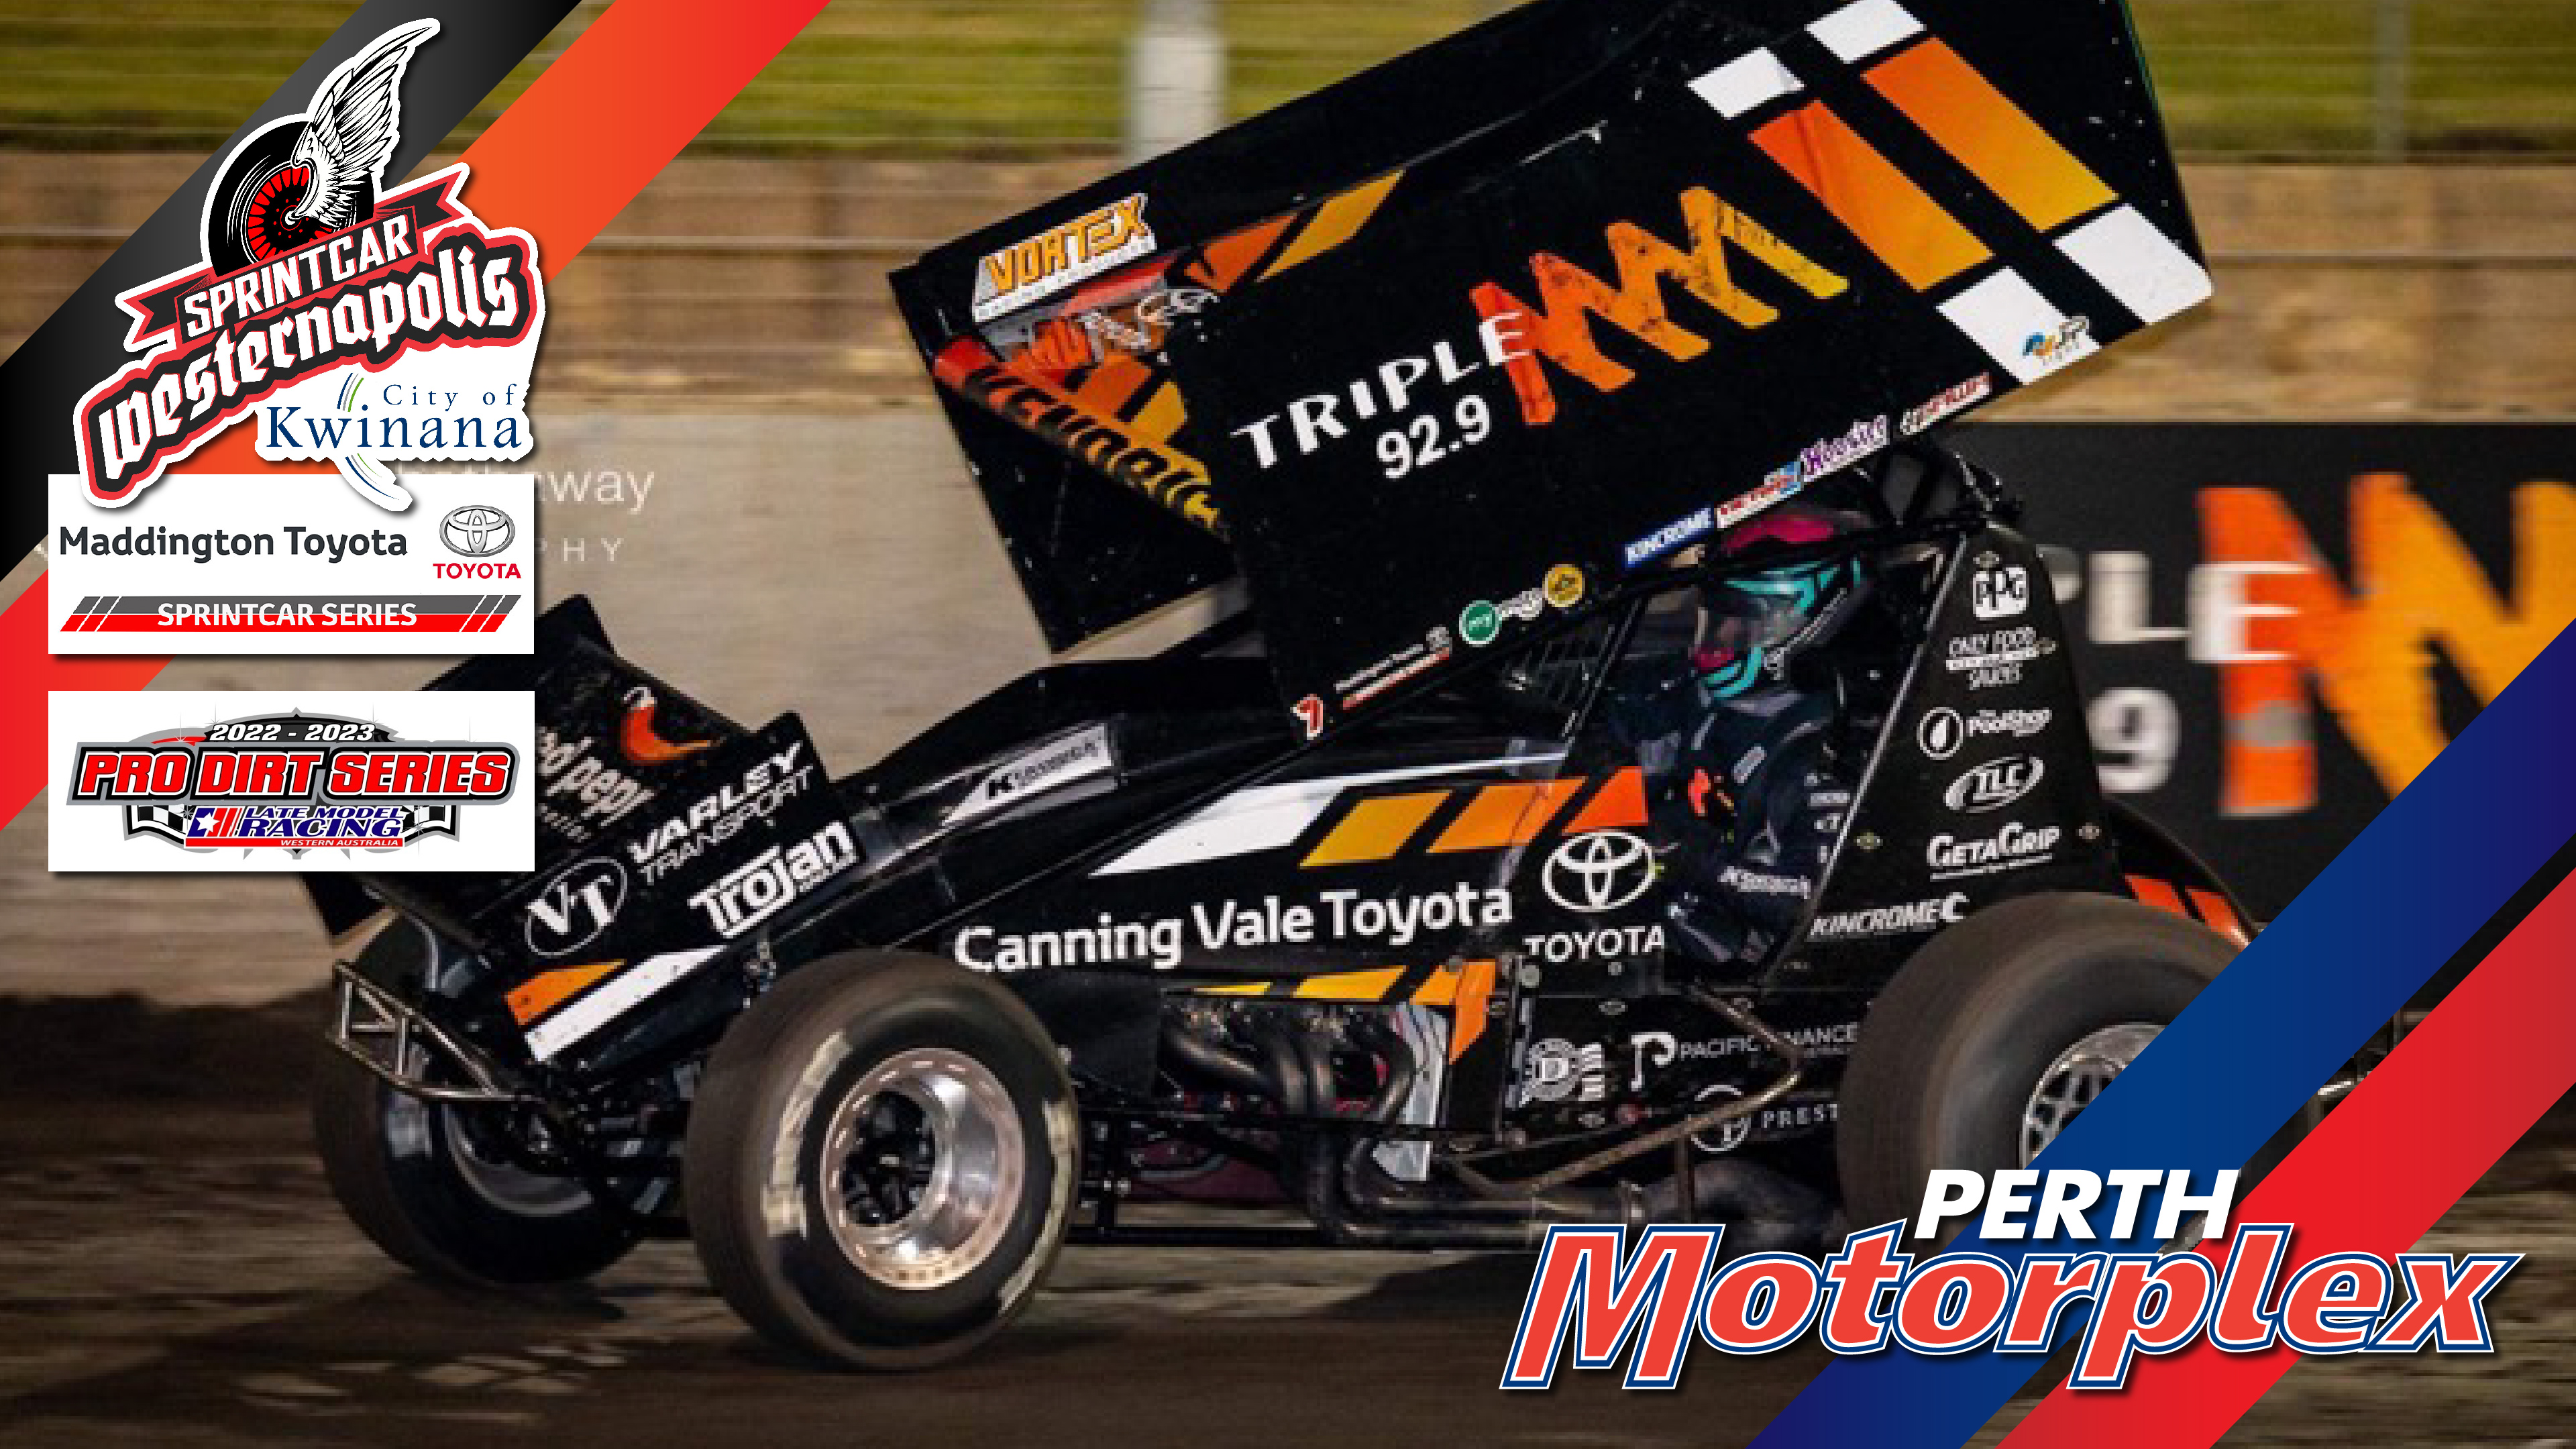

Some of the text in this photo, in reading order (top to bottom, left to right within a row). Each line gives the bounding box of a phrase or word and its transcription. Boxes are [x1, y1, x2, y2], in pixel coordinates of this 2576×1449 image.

[985, 195, 1148, 297] VORTEX
[1230, 311, 1533, 469] TRIPLE
[1375, 395, 1491, 479] 92.9
[627, 741, 802, 863] VARLEY
[639, 765, 814, 884] TRANSPORT
[955, 882, 1513, 973] Canning Vale Toyota
[1522, 924, 1665, 962] TOYOTA
